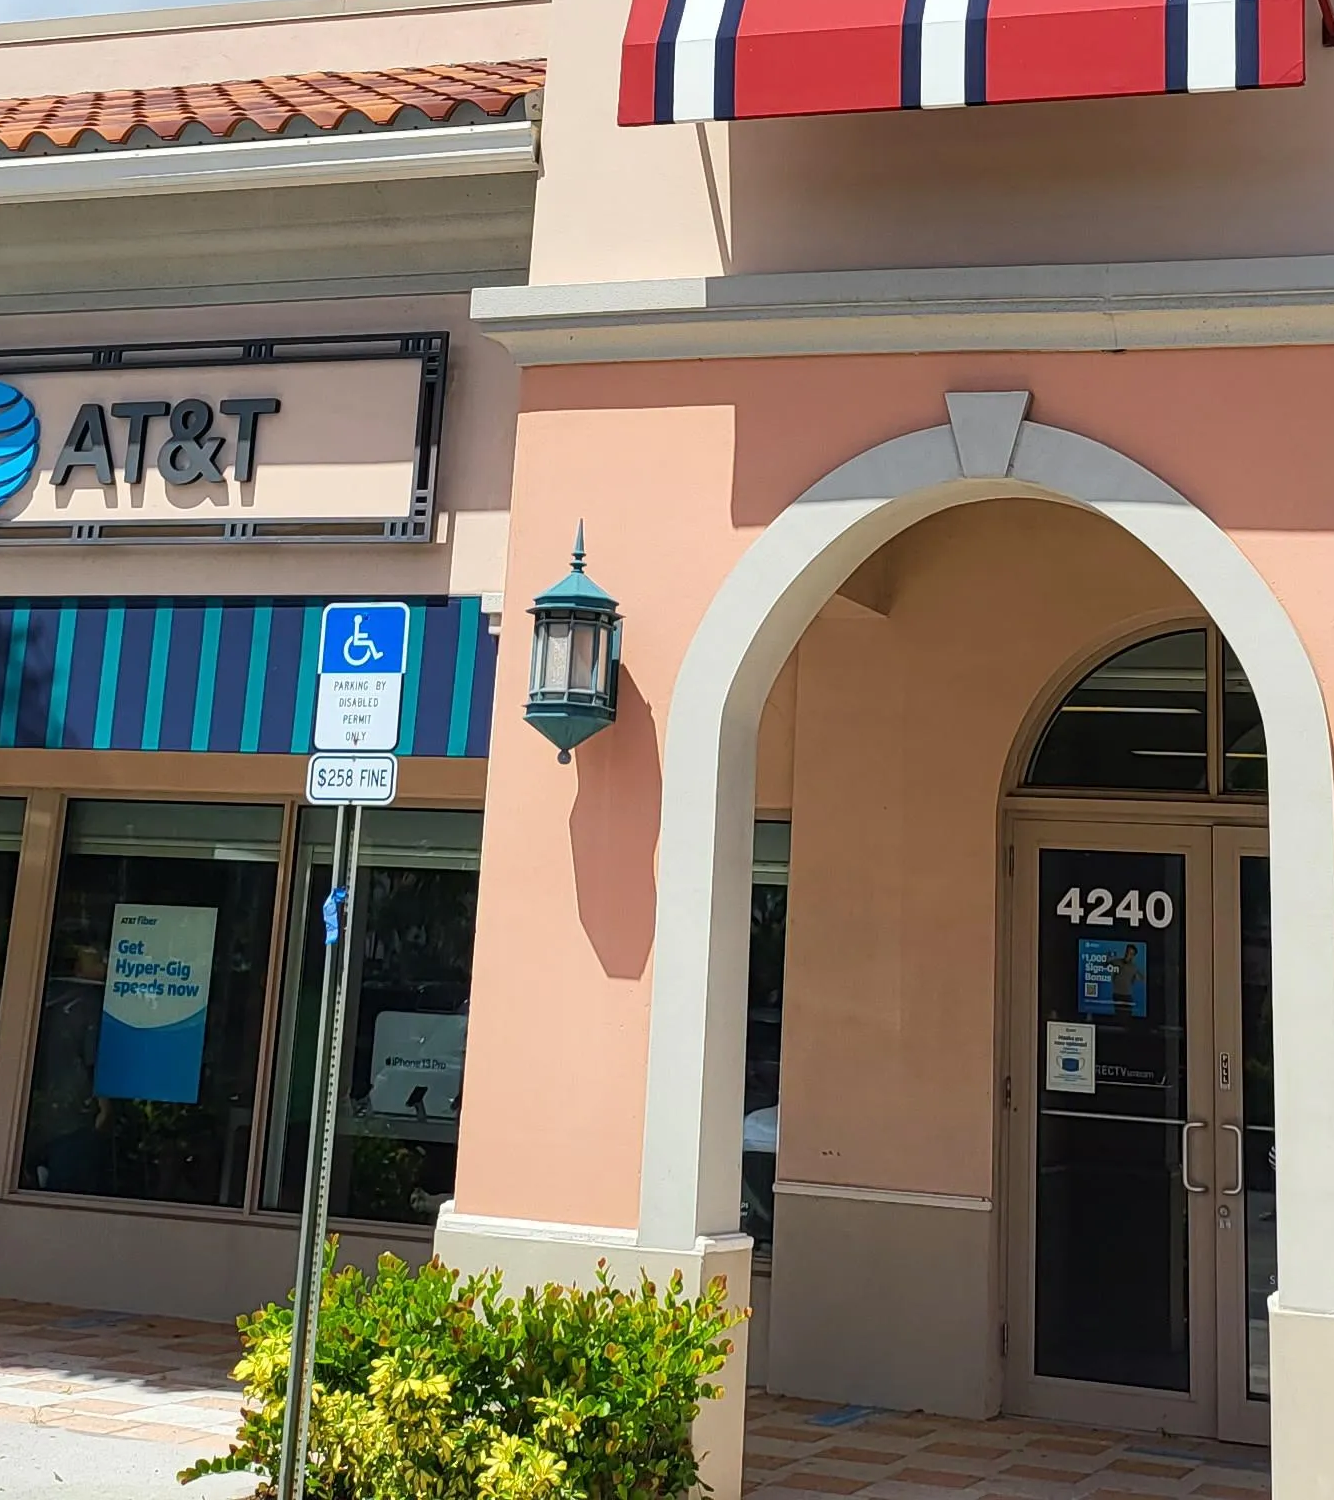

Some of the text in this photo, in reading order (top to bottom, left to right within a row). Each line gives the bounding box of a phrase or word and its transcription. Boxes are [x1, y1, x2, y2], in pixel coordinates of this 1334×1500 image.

[50, 398, 280, 486] AT&T
[334, 681, 387, 691] PARKING BY
[339, 697, 379, 708] DISABLED
[343, 714, 371, 724] PERMIT
[345, 731, 367, 742] ONLY
[317, 768, 387, 788] $258 FINE
[1056, 887, 1174, 929] 4240
[137, 915, 158, 926] fiber
[117, 939, 145, 955] Get
[115, 958, 191, 980] Hyper-Gig
[1085, 963, 1120, 974] Sign-On
[1085, 973, 1112, 982] Bonus
[113, 979, 200, 997] speeds now
[392, 1056, 446, 1070] iPhone 13 Pro
